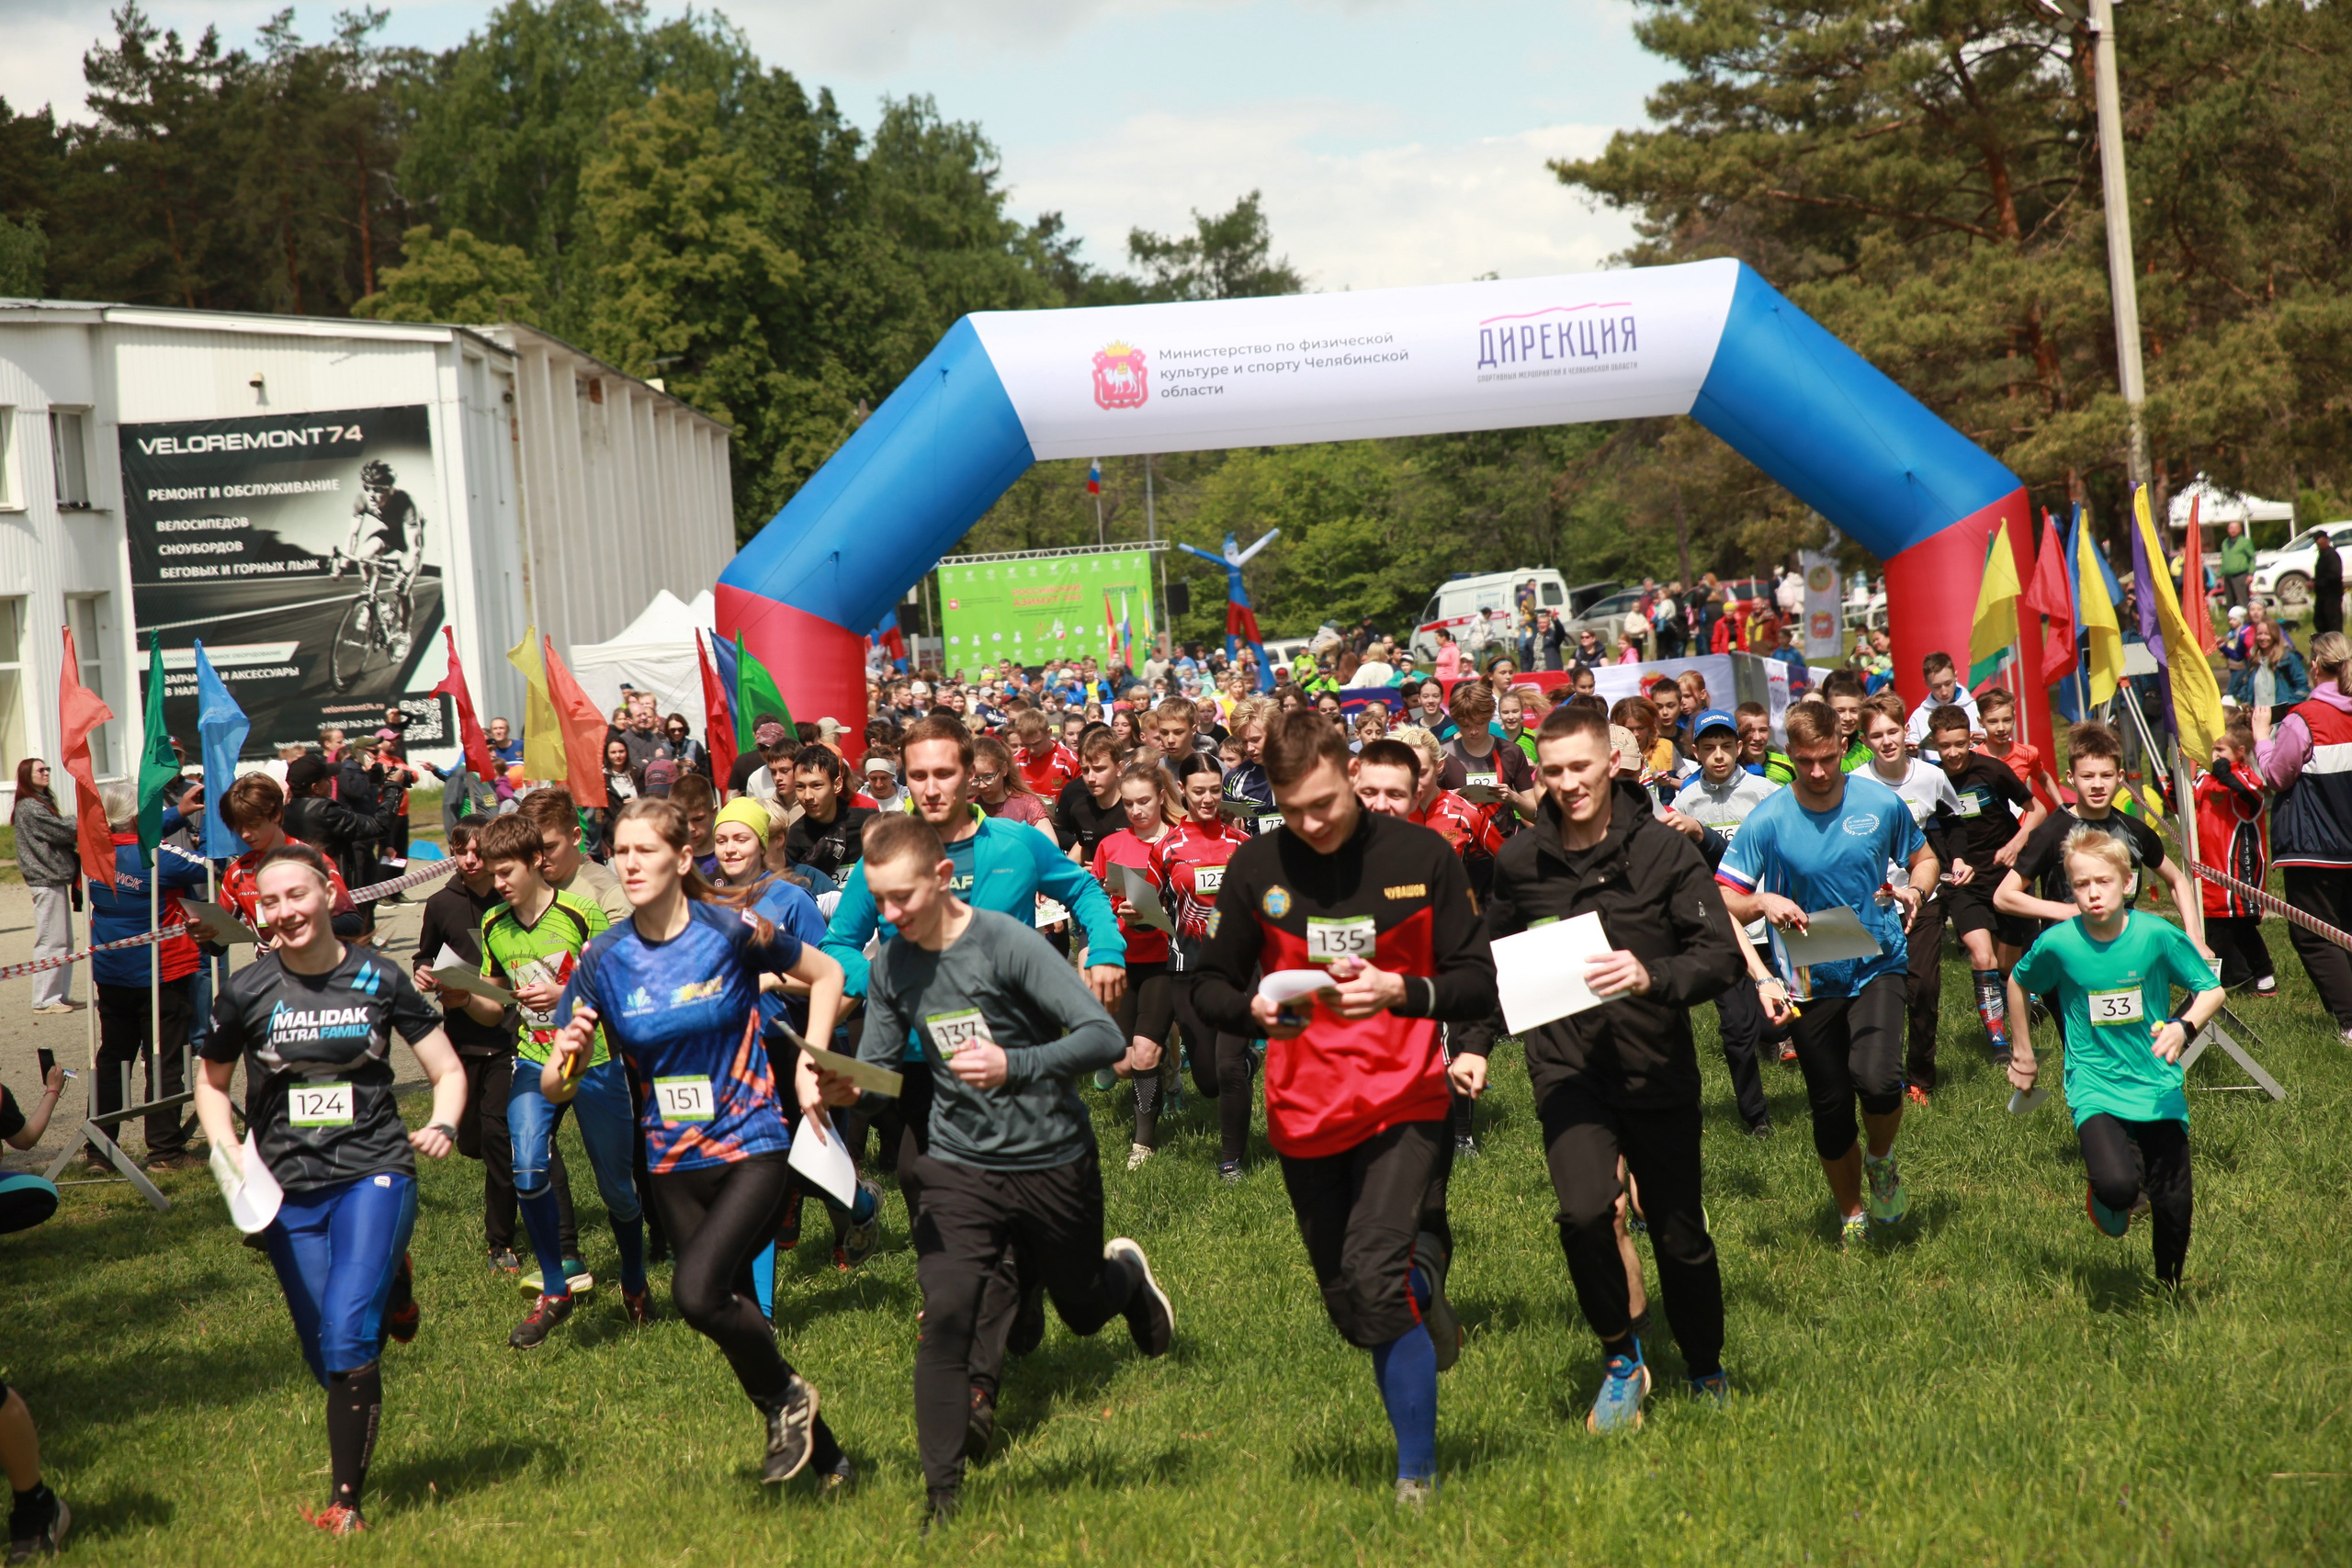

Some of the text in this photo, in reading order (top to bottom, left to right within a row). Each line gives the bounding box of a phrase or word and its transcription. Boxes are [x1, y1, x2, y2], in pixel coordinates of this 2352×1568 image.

[1159, 332, 1394, 361] Министерство по физической
[1477, 316, 1637, 370] ДИРЕКЦИЯ
[1159, 348, 1409, 380] культуре и спорту Челябинской
[1611, 361, 1638, 371] ОБЛАСТИ
[1160, 383, 1224, 398] области
[148, 479, 340, 502] РЕМОНТ И ОБСЛУЖИВАНИЕ
[156, 516, 250, 532] ВЕЛОСИПЕДОВ
[159, 540, 243, 557] СНОУБОРДОВ
[160, 558, 320, 580] БЕГОВЫХ И ГОРНЫХ ЛЫЖ
[1013, 594, 1059, 607] АЗИМУТ
[220, 671, 230, 681] И
[231, 666, 300, 680] АКСЕССУАРЫ
[164, 687, 173, 696] В
[1317, 928, 1365, 953] 135
[510, 960, 519, 970] N
[2101, 997, 2132, 1017] 33
[273, 1007, 369, 1030] MALIDAK
[272, 1023, 371, 1044] ULTRA FAMILY
[936, 1021, 976, 1046] 137
[297, 1092, 345, 1115] 124
[665, 1087, 701, 1110] 151
